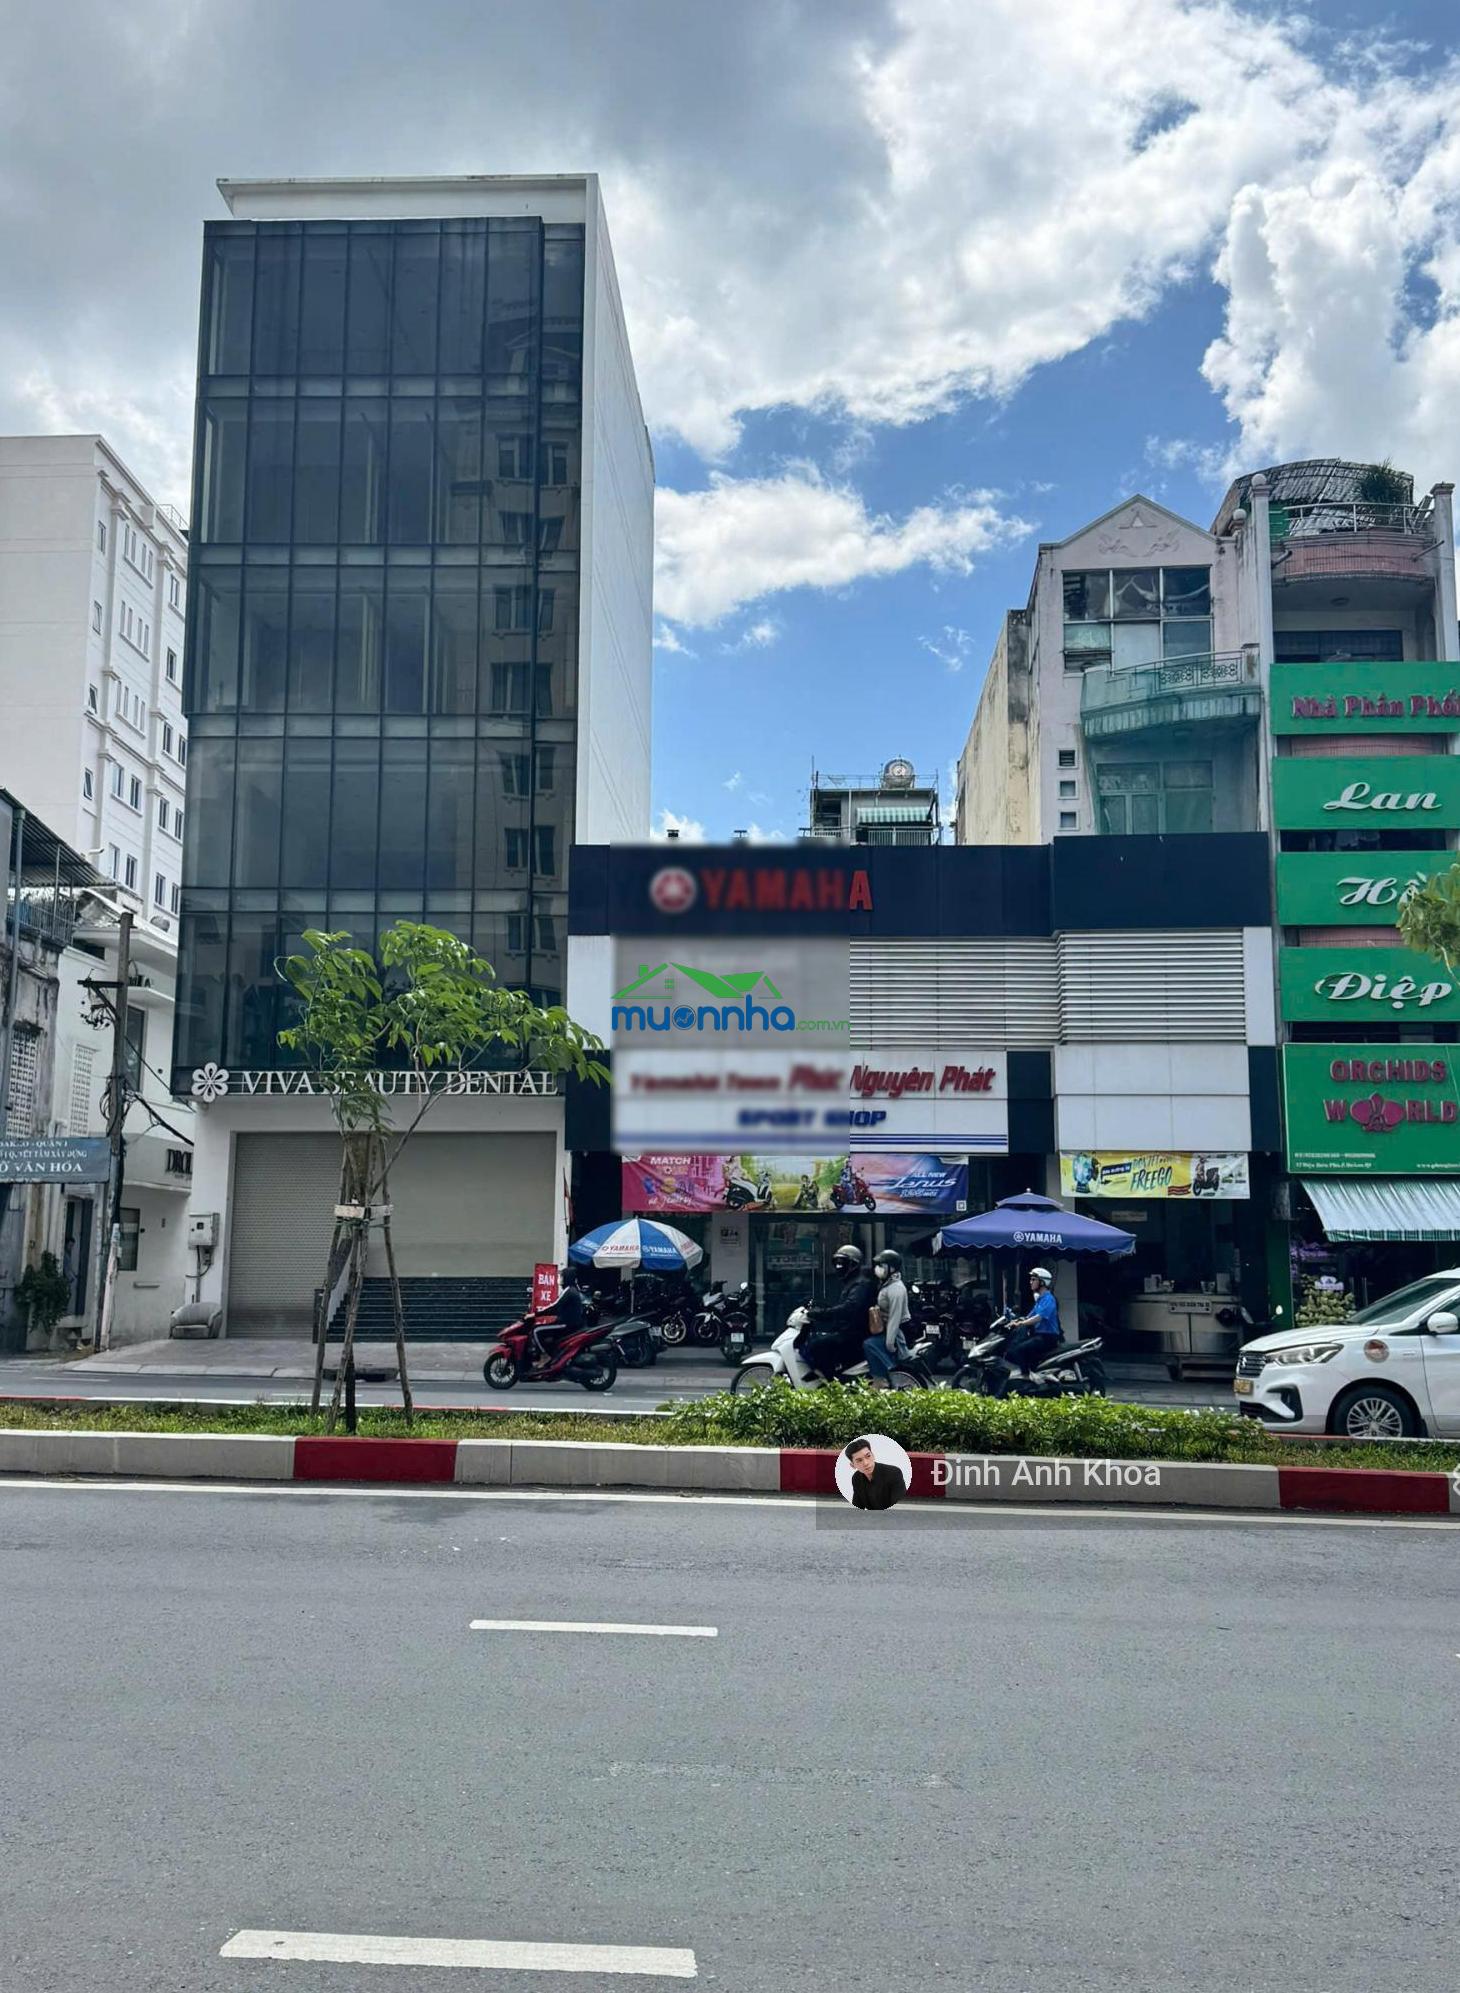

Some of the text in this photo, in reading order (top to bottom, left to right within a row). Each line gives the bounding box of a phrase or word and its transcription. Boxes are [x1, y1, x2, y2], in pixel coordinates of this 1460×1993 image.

[1322, 782, 1442, 810] Lan
[701, 867, 874, 912] YAMAHA
[1314, 972, 1452, 1009] Điệp
[242, 1071, 316, 1095] VIVA
[445, 1070, 558, 1095] DENTAL
[939, 1065, 996, 1092] Phát
[1330, 1059, 1446, 1083] ORCHIDS
[650, 1156, 691, 1165] MATCH
[1126, 1166, 1173, 1192] FREEGO
[1024, 1232, 1062, 1244] YAMAHA
[541, 1290, 552, 1302] XE
